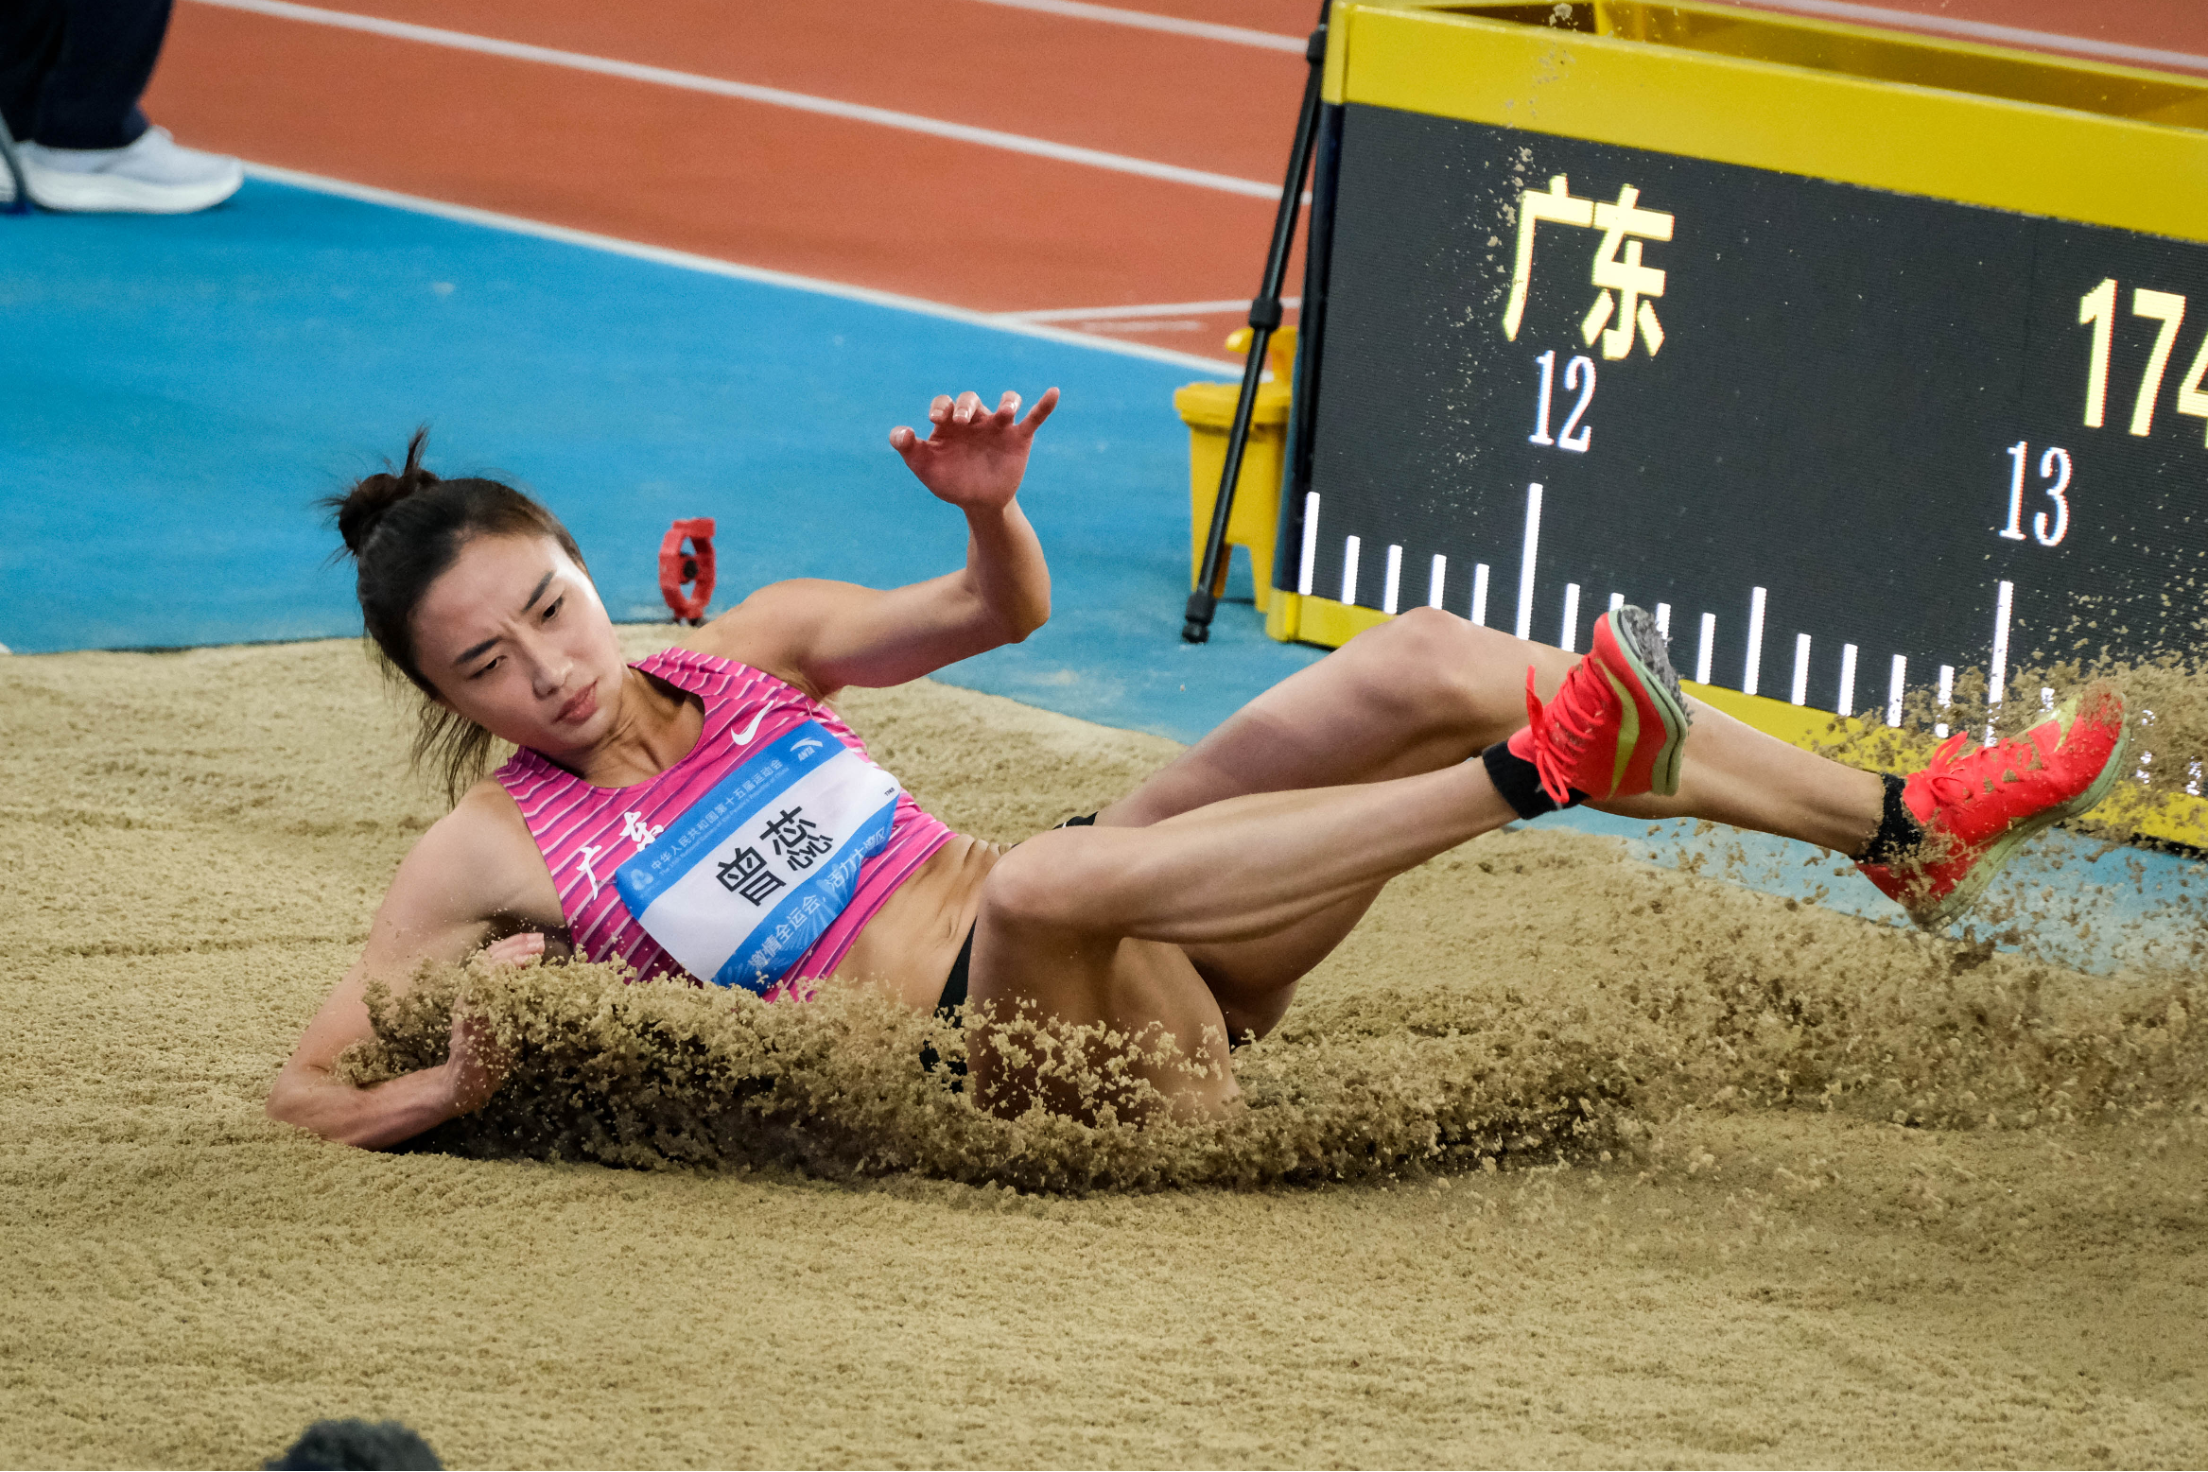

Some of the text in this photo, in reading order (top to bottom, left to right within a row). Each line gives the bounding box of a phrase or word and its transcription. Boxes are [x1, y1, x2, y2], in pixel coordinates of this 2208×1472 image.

[1502, 174, 1675, 360] 广东
[1528, 349, 1597, 452] 12
[1998, 440, 2073, 546] 13
[651, 759, 783, 869] 中华人民共和国第十五届运动会
[715, 806, 833, 907] 曾蕊
